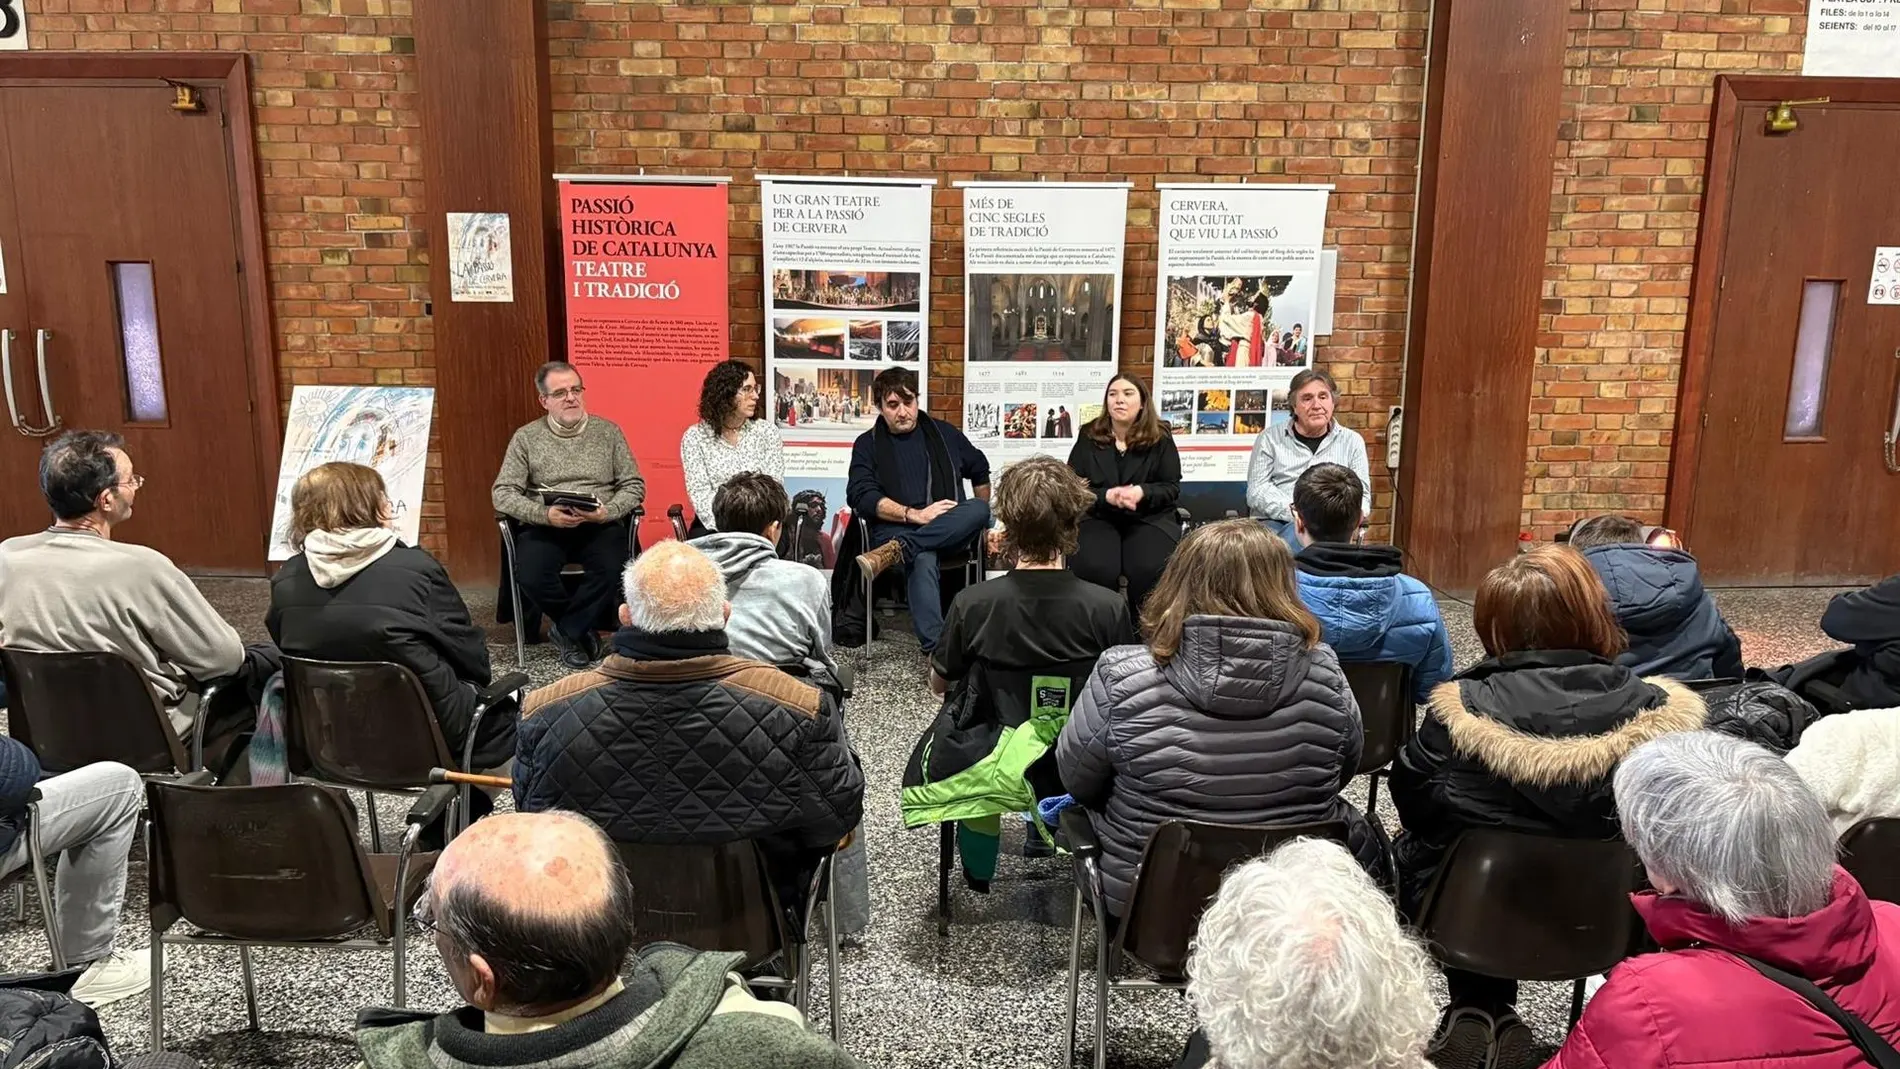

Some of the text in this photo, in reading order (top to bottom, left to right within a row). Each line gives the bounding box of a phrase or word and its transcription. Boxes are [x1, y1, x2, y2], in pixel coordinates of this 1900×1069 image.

[1820, 8, 1847, 16] FILES:
[1819, 22, 1858, 30] SEIENTS:
[572, 196, 634, 214] PASSIÓ
[772, 194, 880, 207] UN GRAN TEATRE
[969, 196, 1014, 209] MÉS DE
[1170, 200, 1228, 211] CERVERA,
[773, 208, 865, 220] PER A LA PASSIÓ
[969, 212, 1045, 223] CINC SEGLES
[1170, 214, 1244, 225] UNA CIUTAT
[572, 216, 676, 236] HISTÒRICA
[773, 222, 848, 234] DE CERVERA
[969, 225, 1048, 237] DE TRADICIÓ
[1169, 227, 1278, 241] QUE VIU LA PASSIÓ
[572, 240, 717, 258] DE CATALUNYA
[572, 260, 647, 278] TEATRE
[573, 280, 680, 300] I TRADICIÓ
